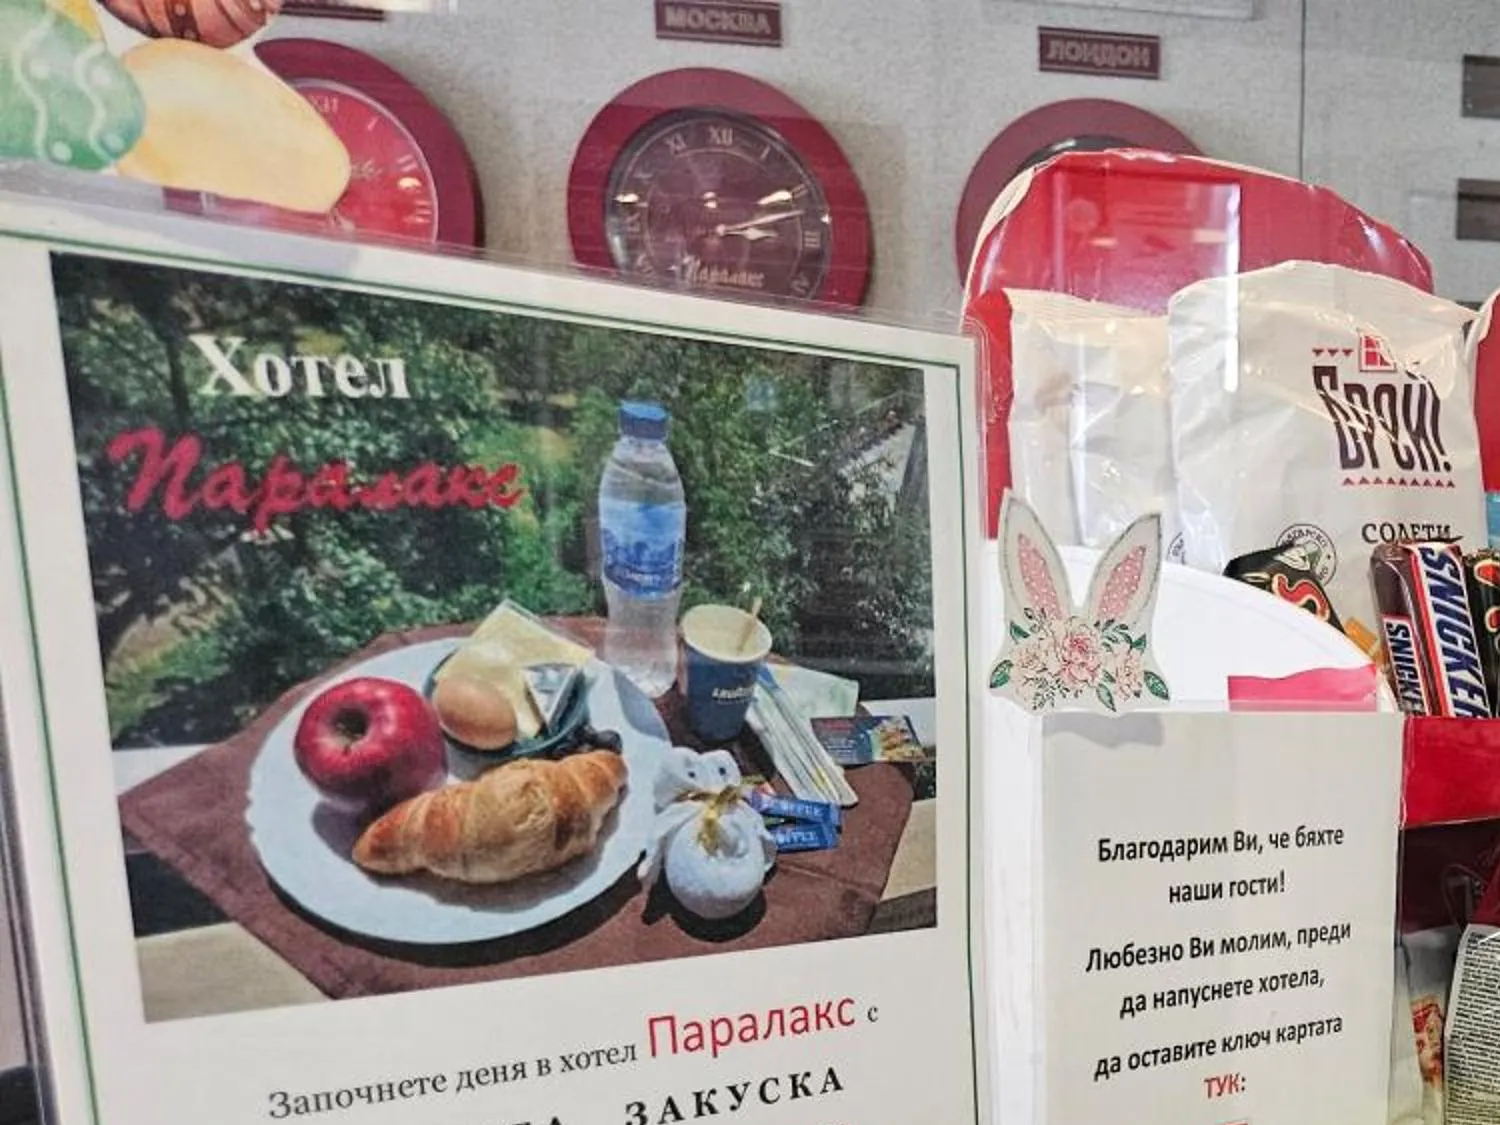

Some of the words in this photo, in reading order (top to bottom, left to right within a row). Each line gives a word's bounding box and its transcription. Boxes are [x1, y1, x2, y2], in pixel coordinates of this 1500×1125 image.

[665, 5, 771, 35] МОСКВА
[188, 333, 410, 399] Хотел
[107, 426, 528, 534] Паралакс
[1419, 547, 1491, 719] SNICKER
[1098, 837, 1229, 863] Благодарим
[1233, 829, 1264, 855] Ви,
[1269, 831, 1291, 849] че
[1295, 825, 1345, 847] бяхте
[1168, 882, 1224, 904] наши
[1228, 869, 1286, 899] гости!
[1086, 941, 1184, 972] Любезно
[1189, 936, 1215, 959] Ви
[1220, 929, 1292, 955] молим,
[1297, 921, 1351, 947] преди
[1120, 993, 1147, 1020] да
[1153, 977, 1253, 1010] напуснете
[1259, 968, 1325, 995] хотела,
[268, 1071, 448, 1121] Започнете
[454, 1058, 529, 1096] деня
[536, 1055, 553, 1079] в
[560, 1041, 639, 1075] хотел
[647, 995, 857, 1060] Паралакс
[866, 1004, 880, 1025] с
[1094, 1056, 1121, 1082] да
[1128, 1038, 1217, 1071] оставите
[1221, 1028, 1273, 1053] ключ
[1276, 1016, 1343, 1046] картата
[1203, 1072, 1247, 1100] ТУК:
